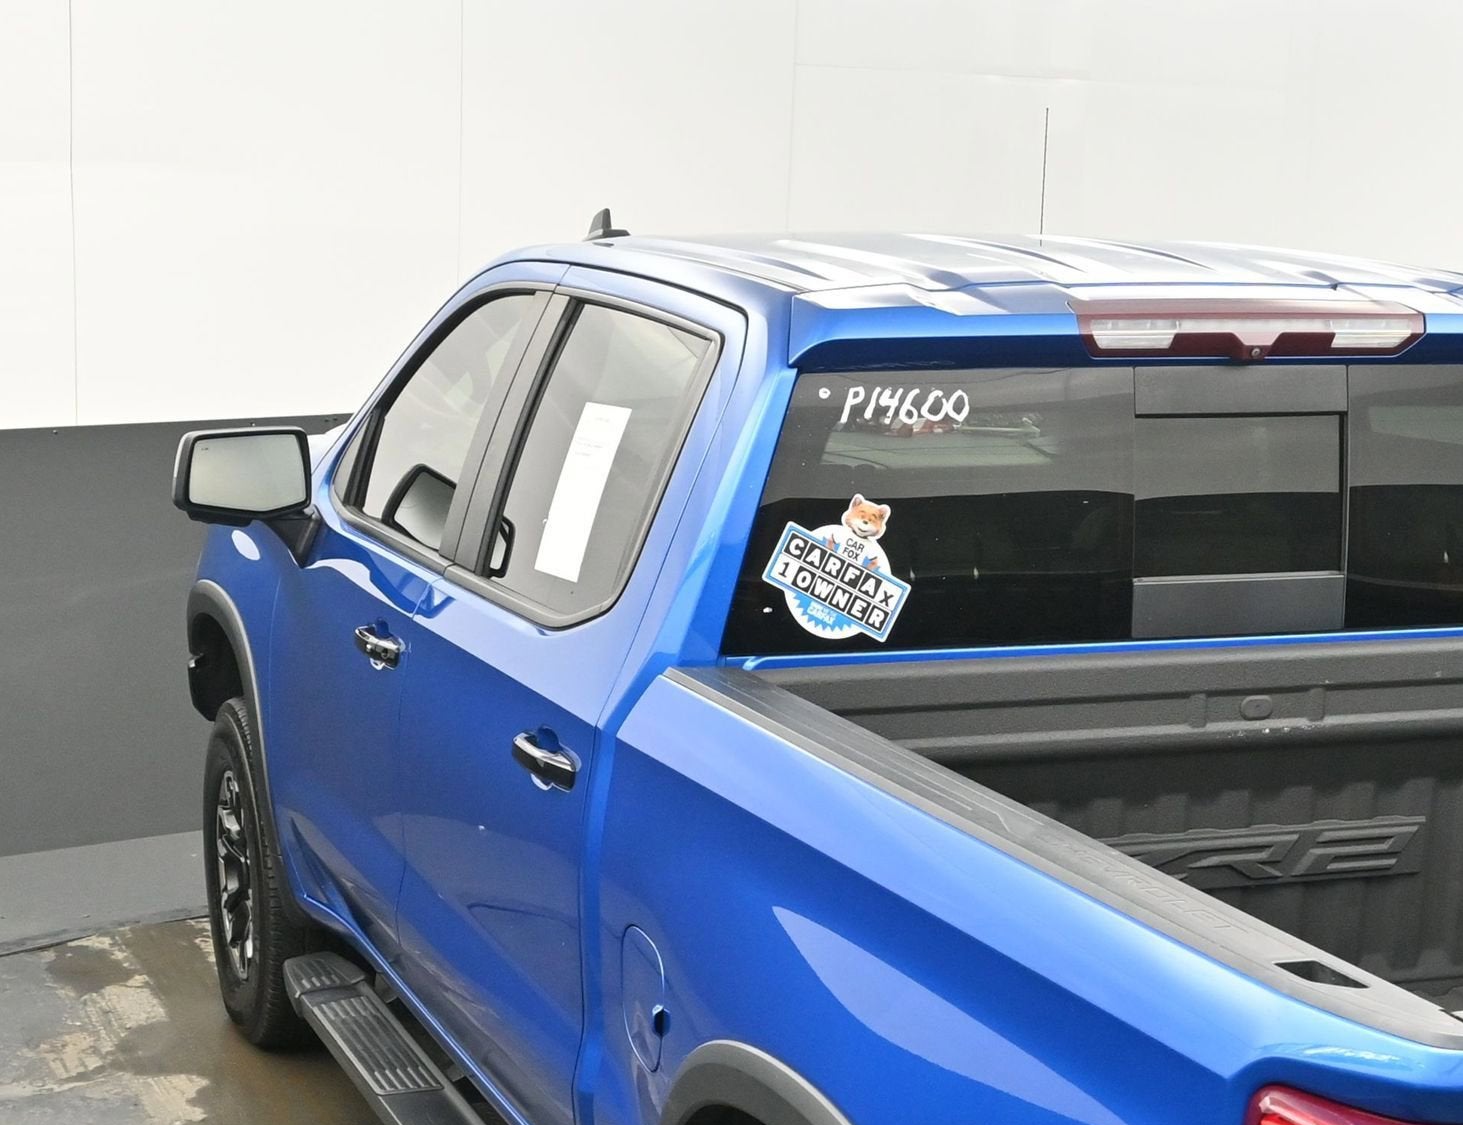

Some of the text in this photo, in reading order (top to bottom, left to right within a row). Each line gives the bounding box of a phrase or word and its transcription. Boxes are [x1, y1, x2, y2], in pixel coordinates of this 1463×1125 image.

[839, 386, 970, 424] P14600
[842, 547, 861, 561] FOX
[845, 538, 865, 552] CAR
[788, 537, 895, 608] CARFAX
[778, 561, 886, 629] 1 OWNER
